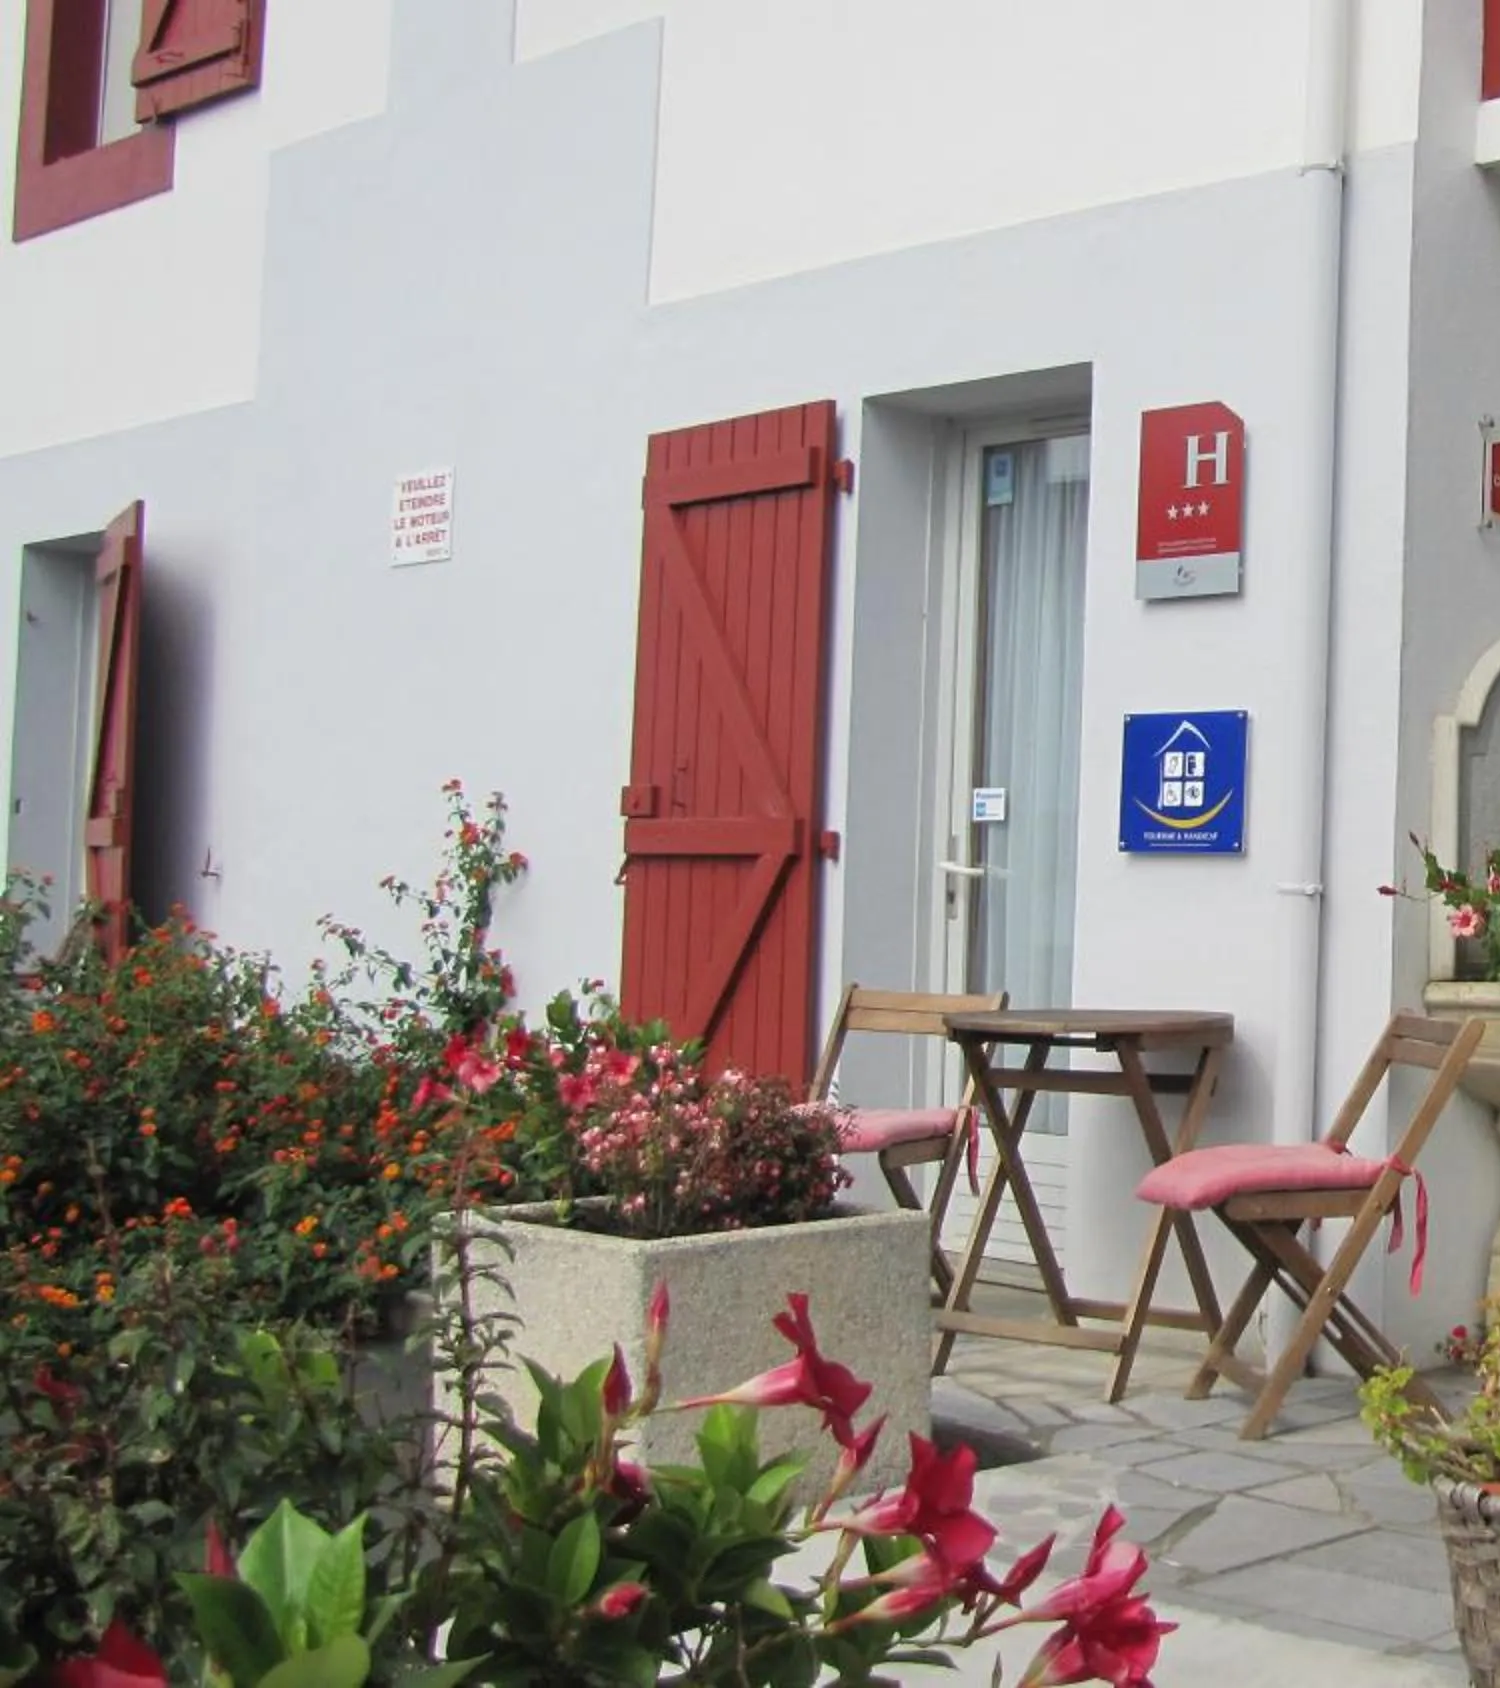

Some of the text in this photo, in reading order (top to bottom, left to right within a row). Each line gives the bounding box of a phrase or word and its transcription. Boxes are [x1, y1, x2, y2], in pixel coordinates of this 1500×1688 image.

[1182, 430, 1233, 489] H
[401, 474, 446, 493] VEUILLEZ
[399, 492, 446, 512] ETEINDRE
[394, 510, 450, 531] LE MOTEUR
